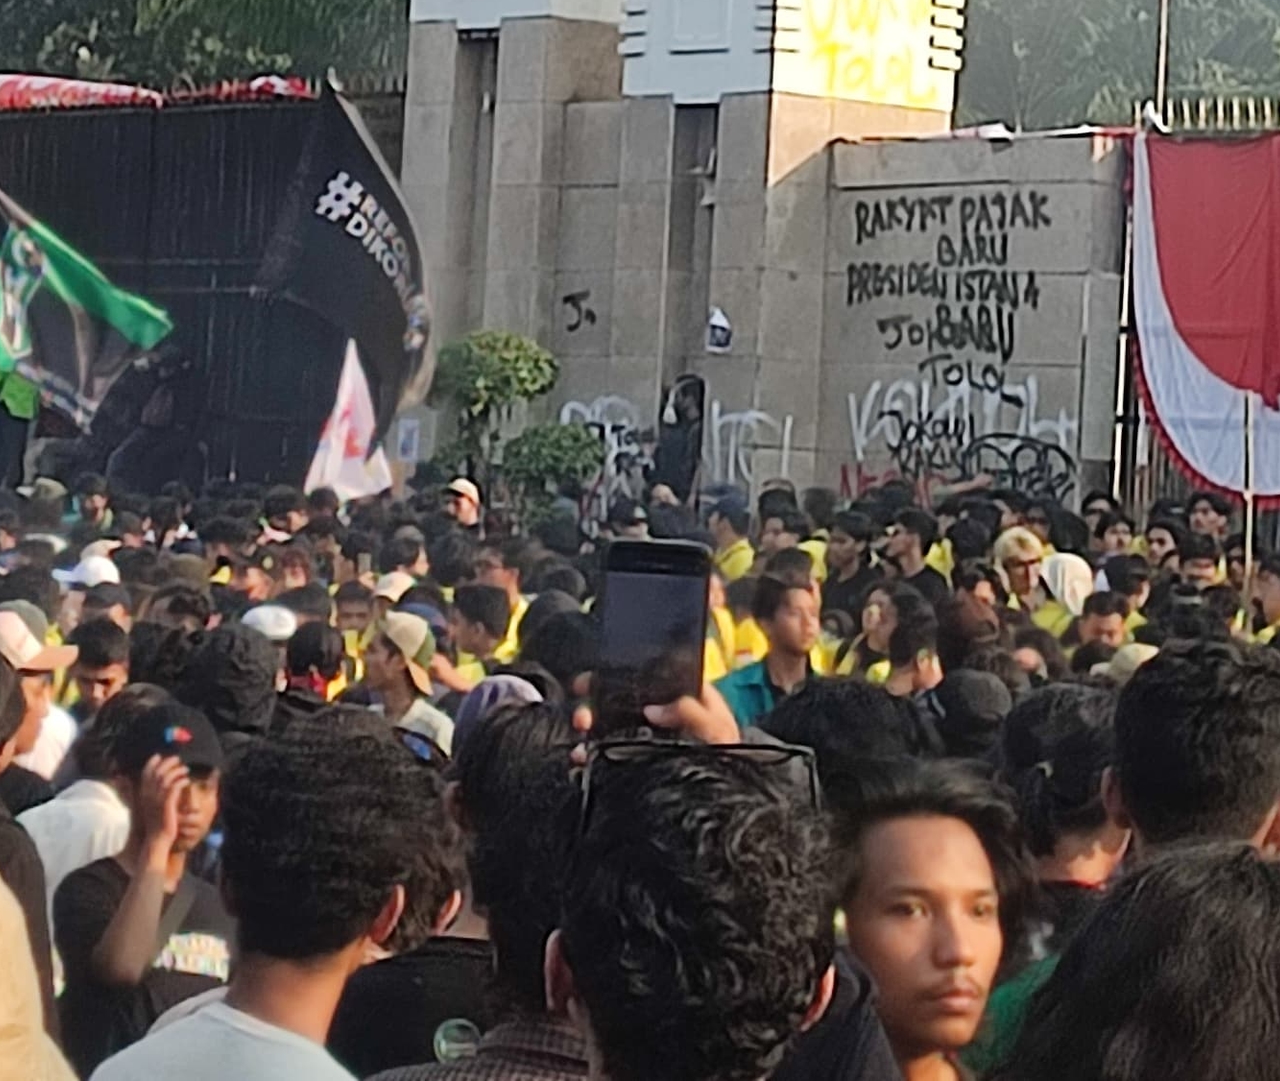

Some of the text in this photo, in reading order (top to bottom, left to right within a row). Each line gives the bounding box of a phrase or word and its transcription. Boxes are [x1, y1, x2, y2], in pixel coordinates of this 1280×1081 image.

[855, 190, 1052, 245] RAKYAT PAJAK
[937, 232, 1008, 267] BARU
[846, 261, 947, 307] PRESIDEN
